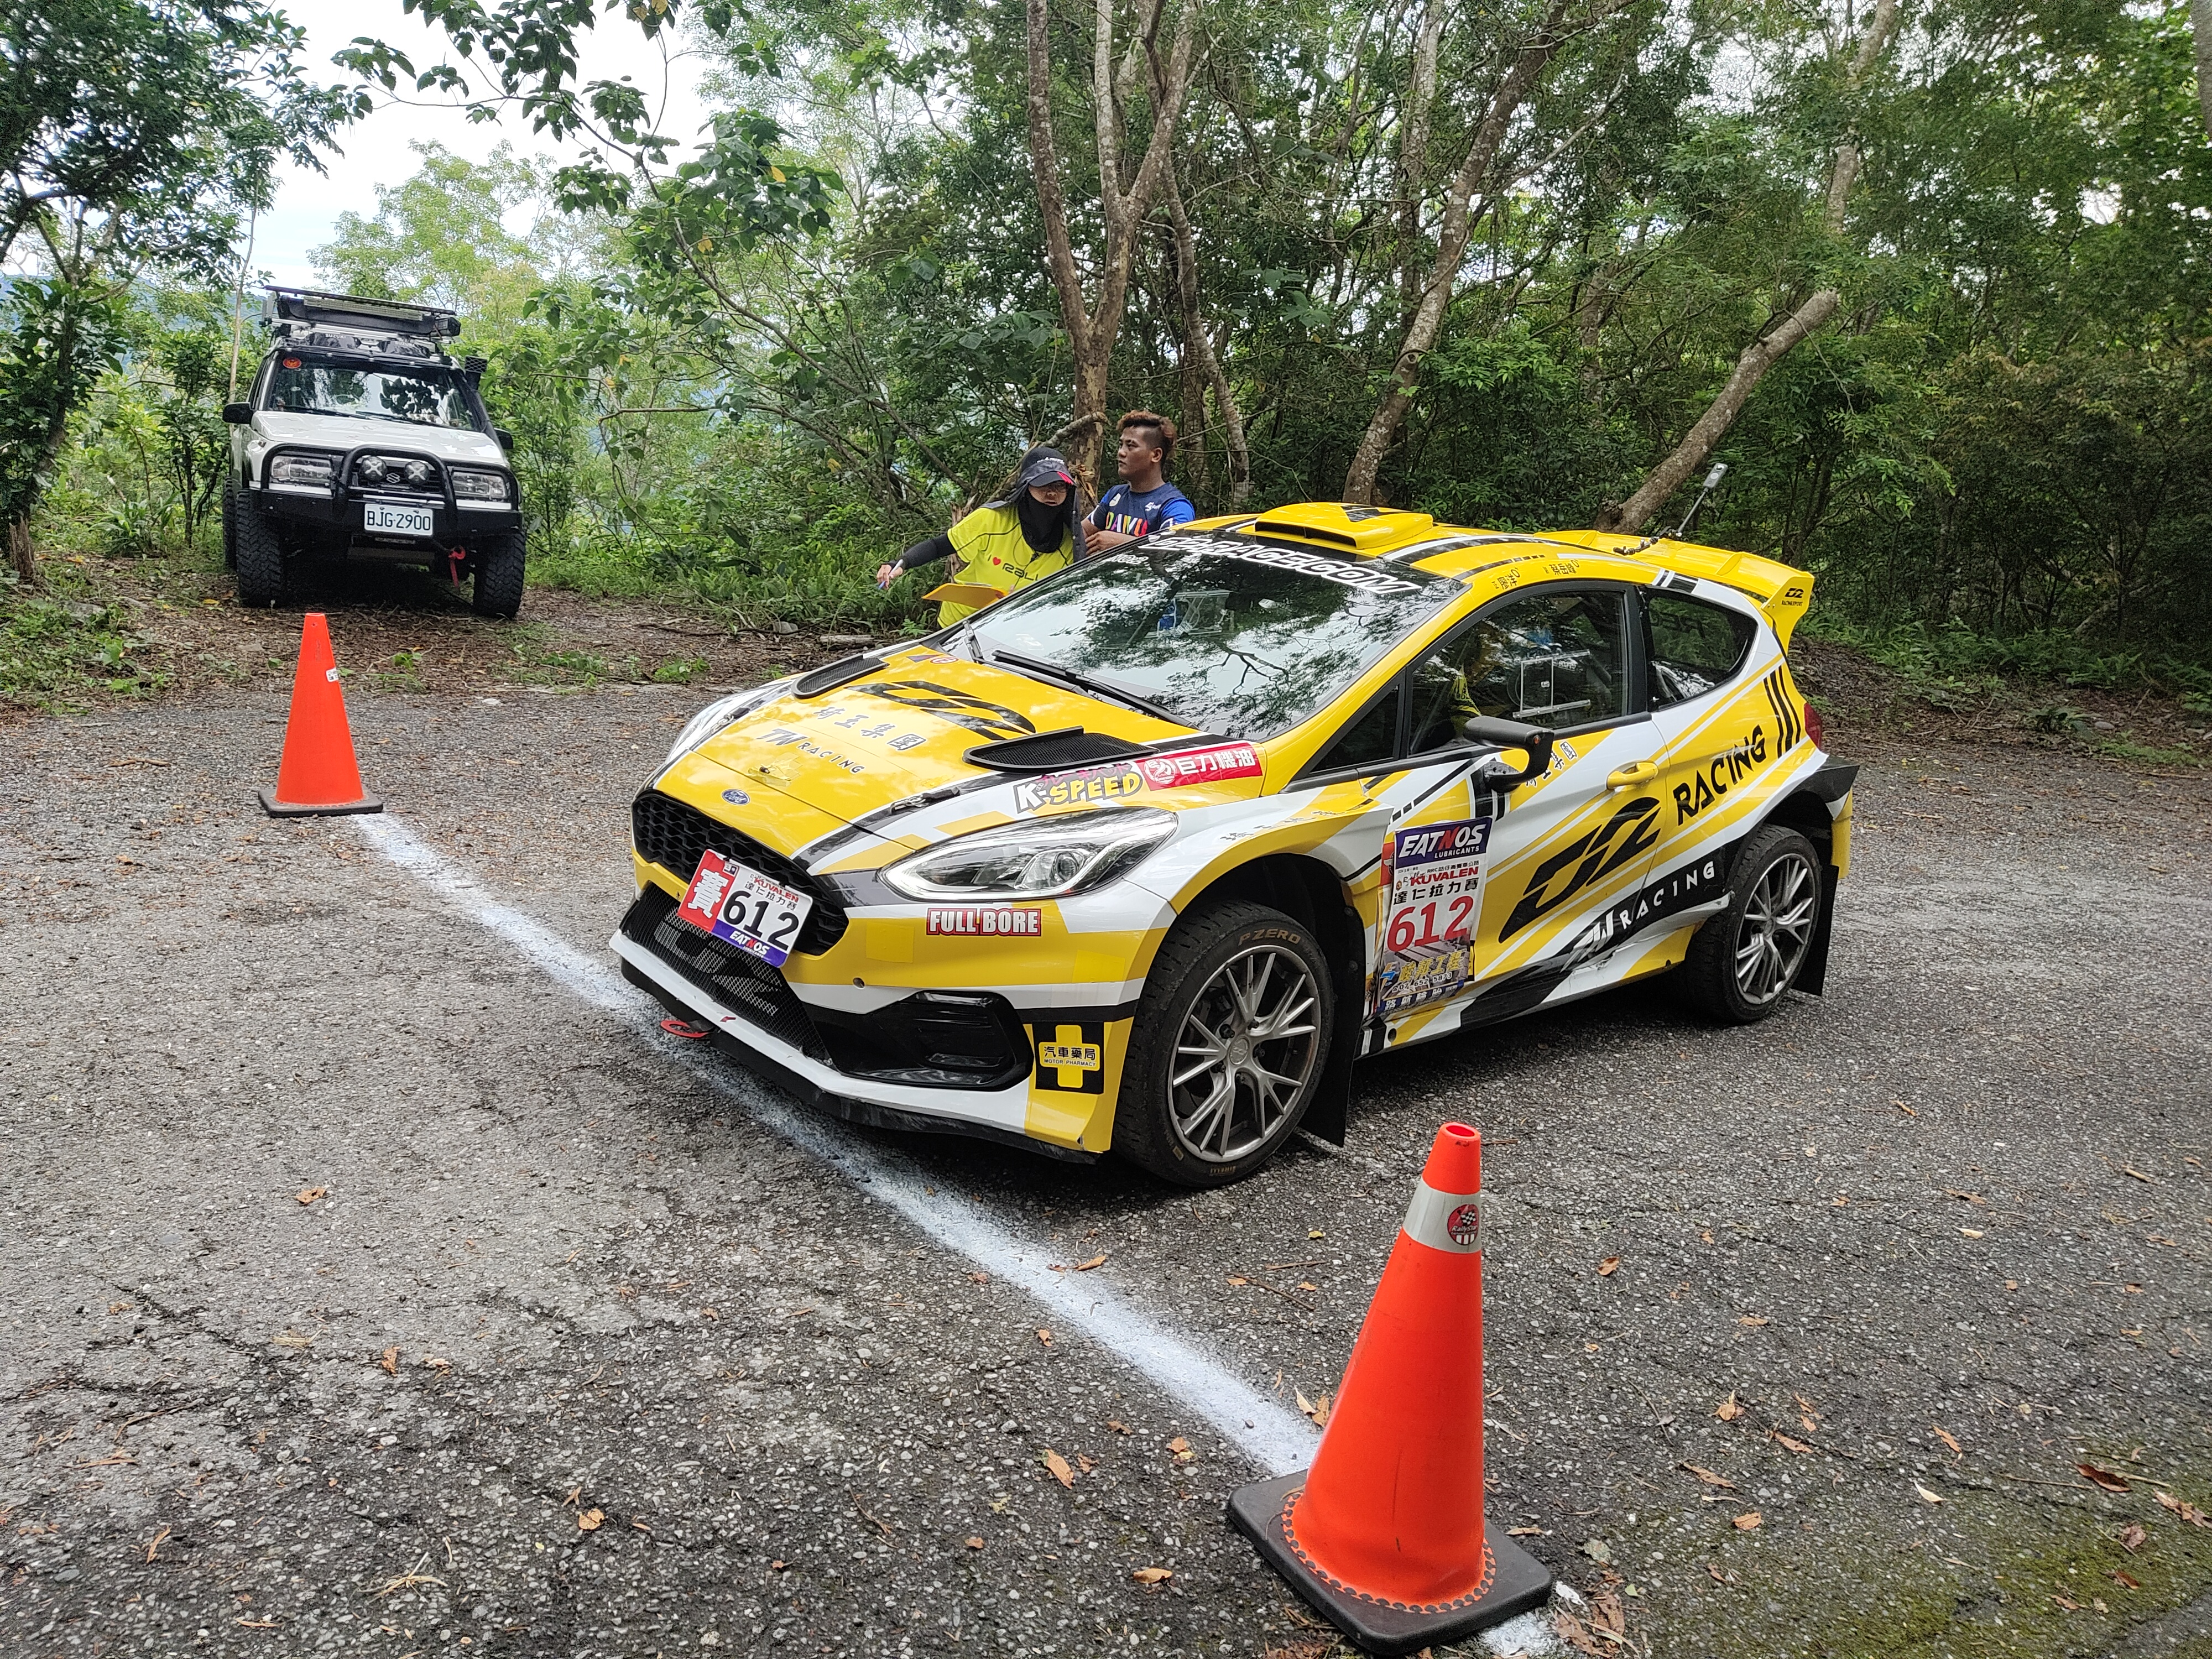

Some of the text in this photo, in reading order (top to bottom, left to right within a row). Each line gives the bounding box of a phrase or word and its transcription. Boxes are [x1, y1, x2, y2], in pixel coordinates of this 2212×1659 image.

[367, 510, 431, 531] BJG-2900
[797, 742, 865, 774] RACING
[1174, 749, 1256, 775] 巨力機油
[1673, 724, 1767, 826] RACING
[724, 790, 747, 804] Ford
[1015, 772, 1142, 812] K-SPEED
[1399, 823, 1487, 858] EATNOS
[1434, 846, 1480, 859] LUBRICANTS
[1410, 866, 1479, 886] KUVALEN
[687, 868, 729, 919] 賽
[754, 877, 799, 903] KUVALEN
[1393, 877, 1479, 905] 達仁拉力賽
[1619, 860, 1715, 930] RACING
[723, 890, 799, 951] 612
[929, 910, 1039, 933] FULL BORE
[1387, 896, 1475, 952] 612
[729, 930, 770, 956] EATNOS
[1433, 972, 1452, 982] 5873
[1044, 1046, 1096, 1061] 汽車藥局
